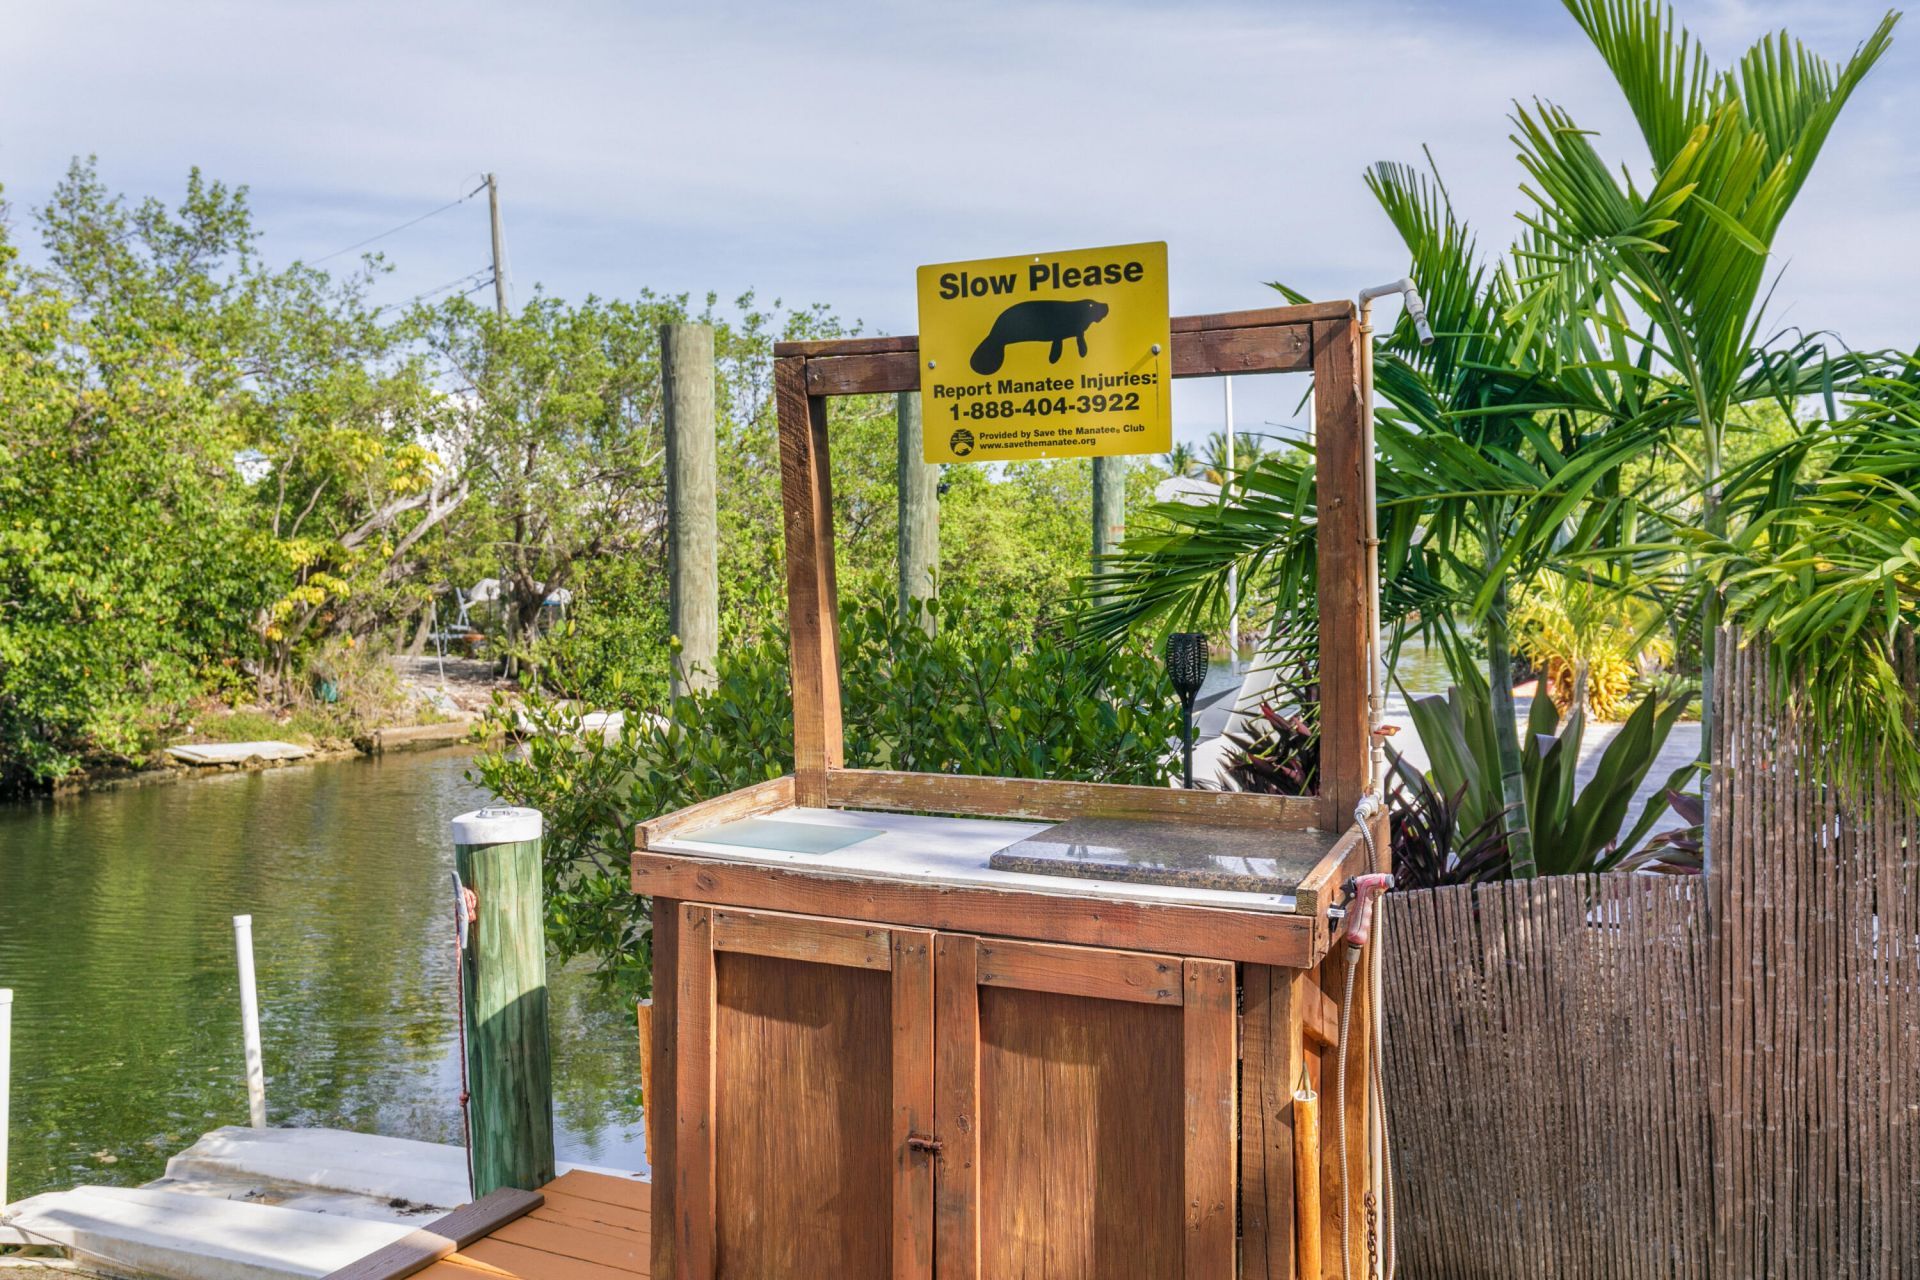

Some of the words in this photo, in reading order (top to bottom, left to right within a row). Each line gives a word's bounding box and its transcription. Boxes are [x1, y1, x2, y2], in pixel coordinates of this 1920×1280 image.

[939, 271, 1017, 300] Slow
[1029, 261, 1144, 291] Please
[934, 381, 992, 400] Report
[998, 374, 1074, 394] Manatee
[1081, 371, 1157, 391] Injuries:
[950, 392, 1140, 421] 1-888-404-3922
[980, 430, 1018, 440] Provided
[1021, 430, 1031, 439] by
[1033, 428, 1056, 437] Save
[1058, 428, 1072, 436] the
[1123, 424, 1145, 433] Club
[980, 437, 1096, 450] www.savethemanatee.org
